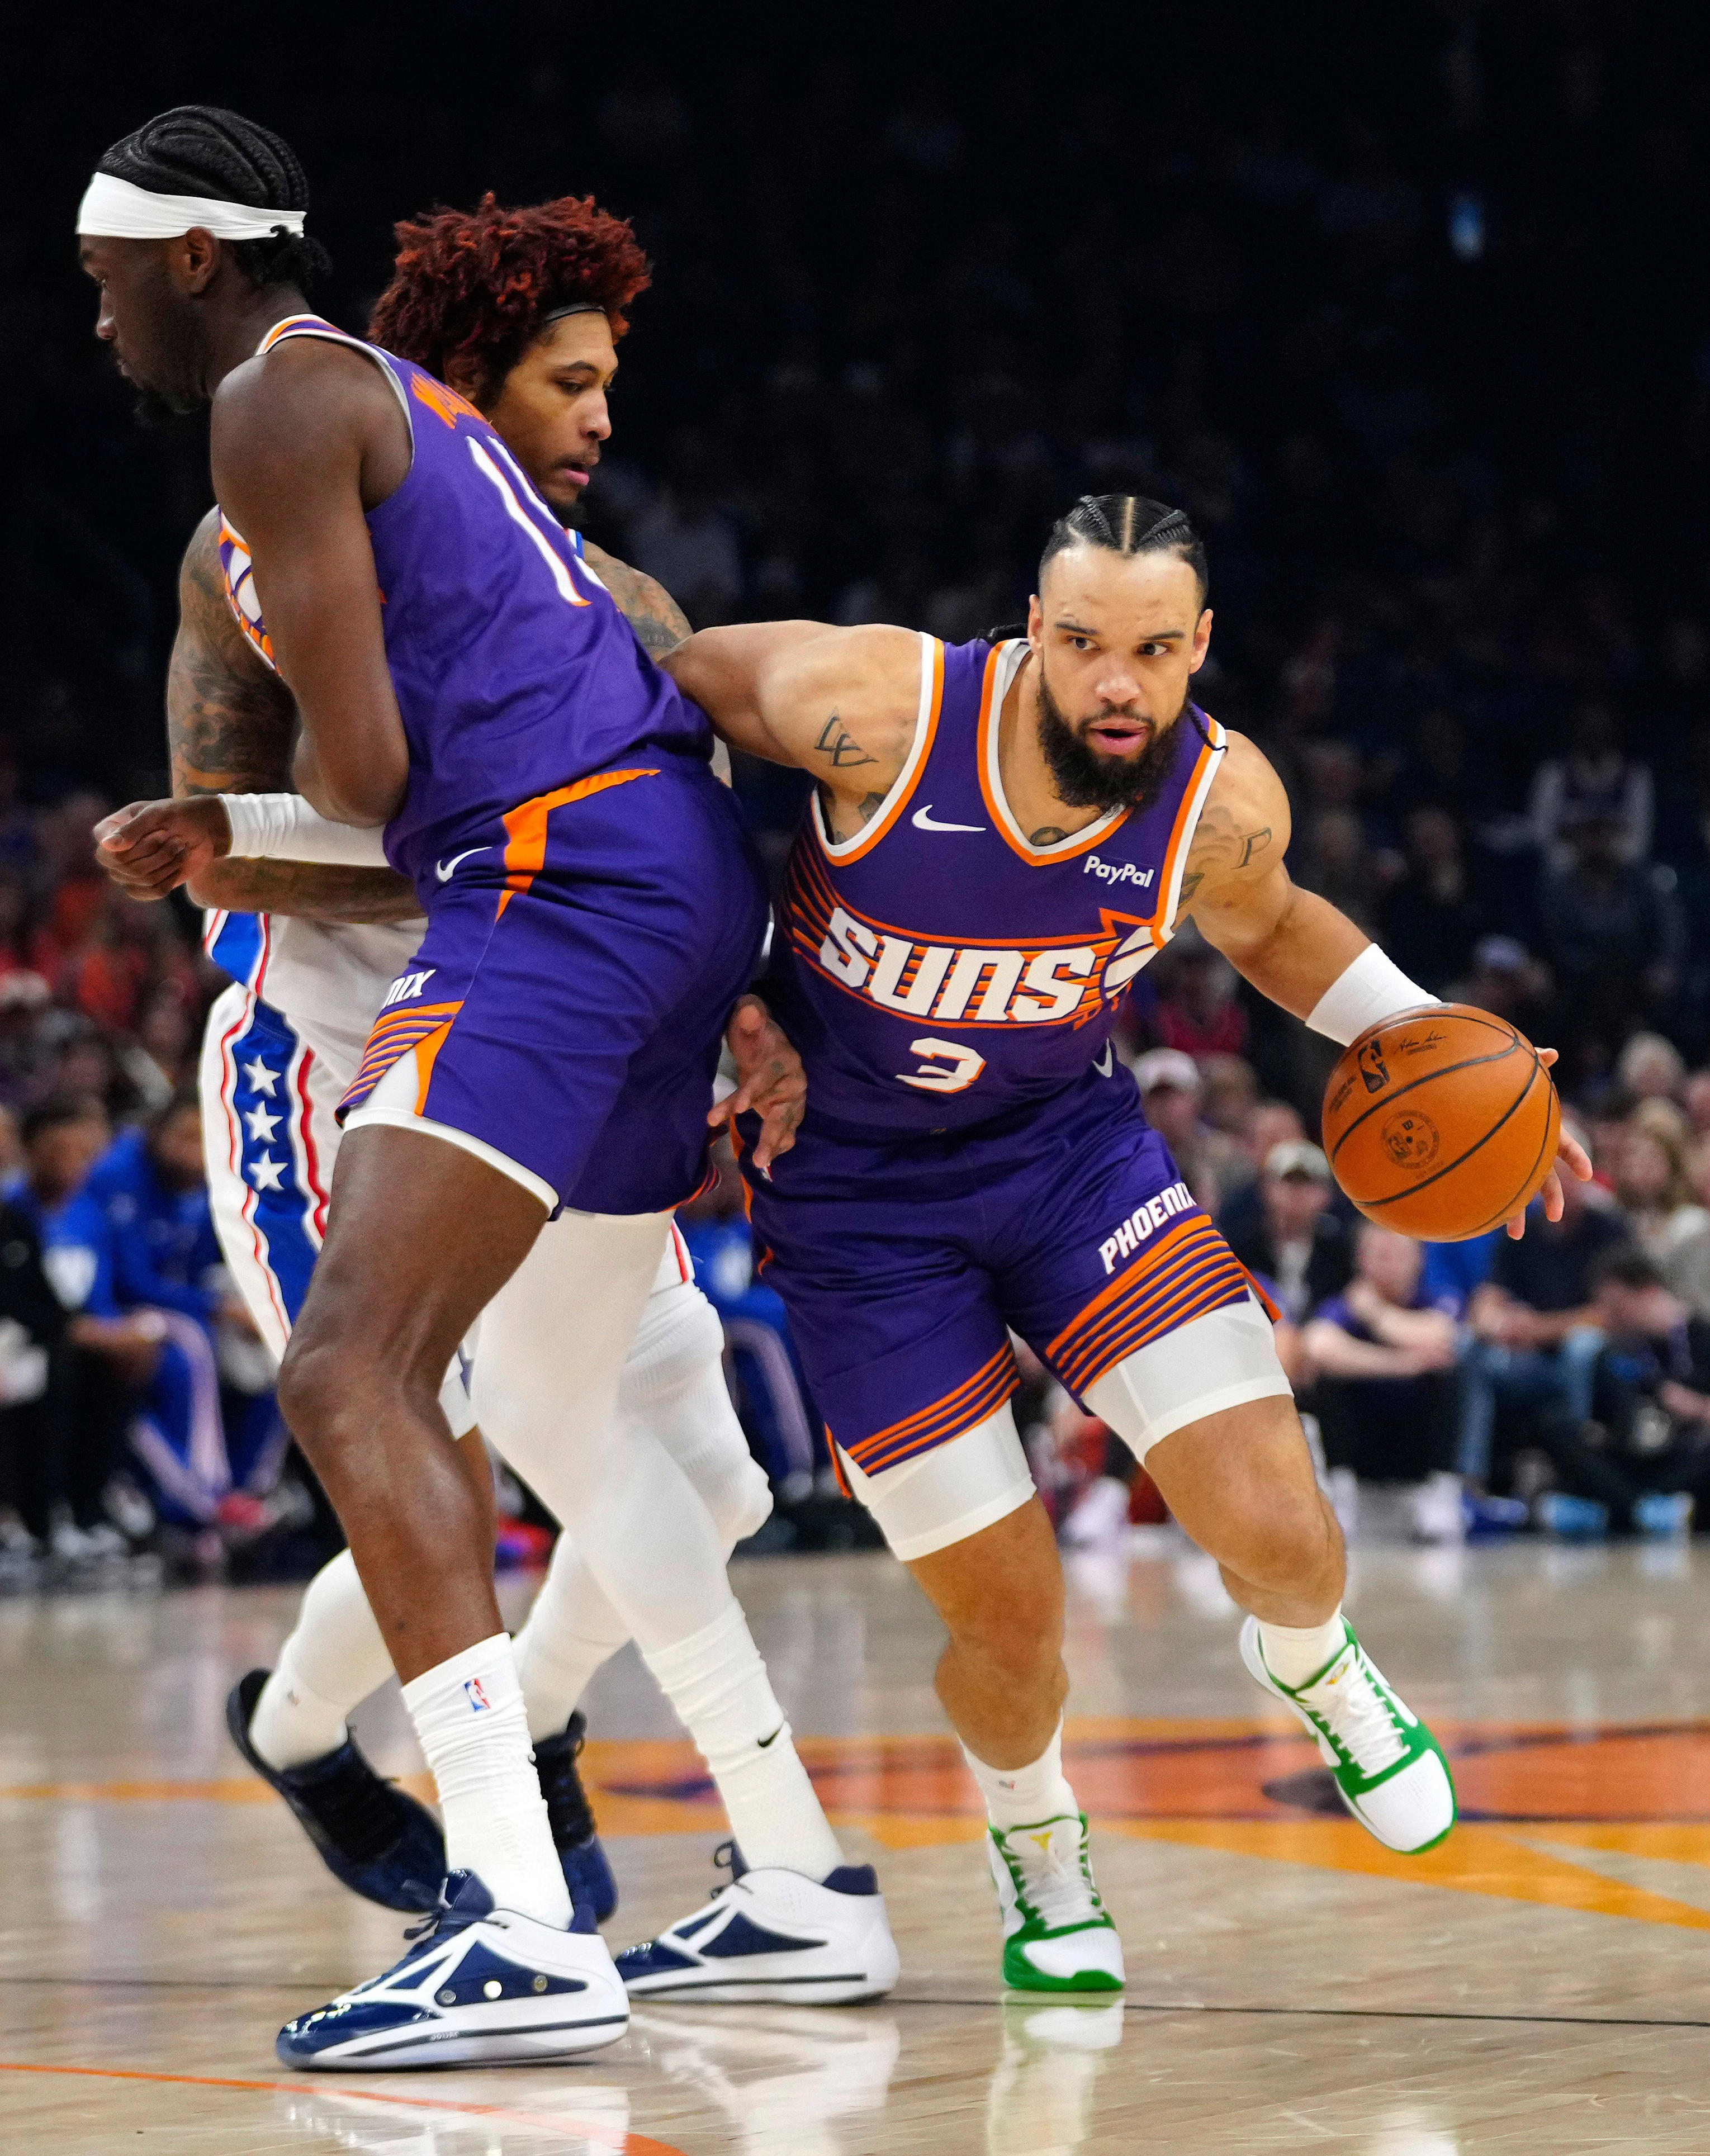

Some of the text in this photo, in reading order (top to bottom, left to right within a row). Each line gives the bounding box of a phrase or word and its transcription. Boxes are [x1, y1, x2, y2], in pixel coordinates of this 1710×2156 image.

[465, 435, 611, 607] 1
[1083, 855, 1155, 888] PayPal
[820, 907, 1097, 1022] SUNS
[895, 1037, 986, 1094] 3
